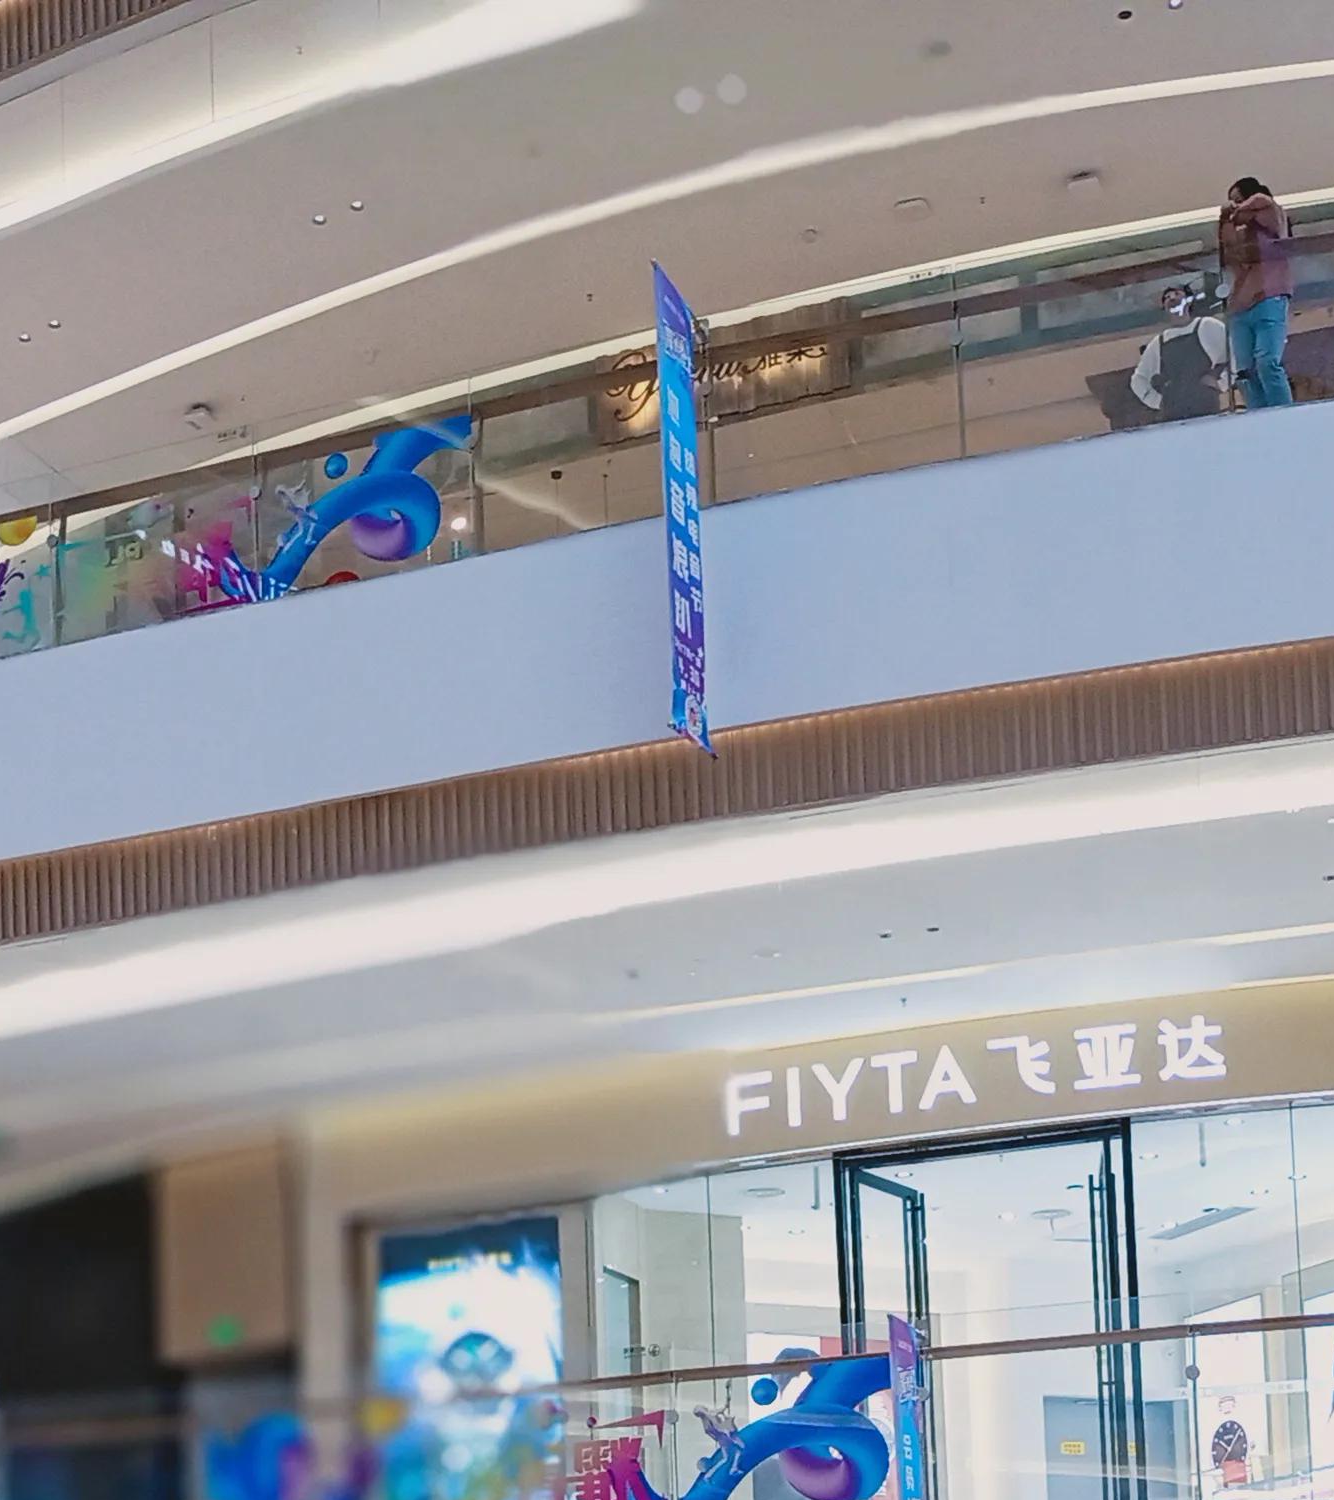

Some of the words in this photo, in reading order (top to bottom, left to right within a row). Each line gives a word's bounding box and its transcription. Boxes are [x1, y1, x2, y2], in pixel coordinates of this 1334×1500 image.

[724, 1044, 978, 1137] FIYTA
[987, 1014, 1229, 1096] 飞亚达
